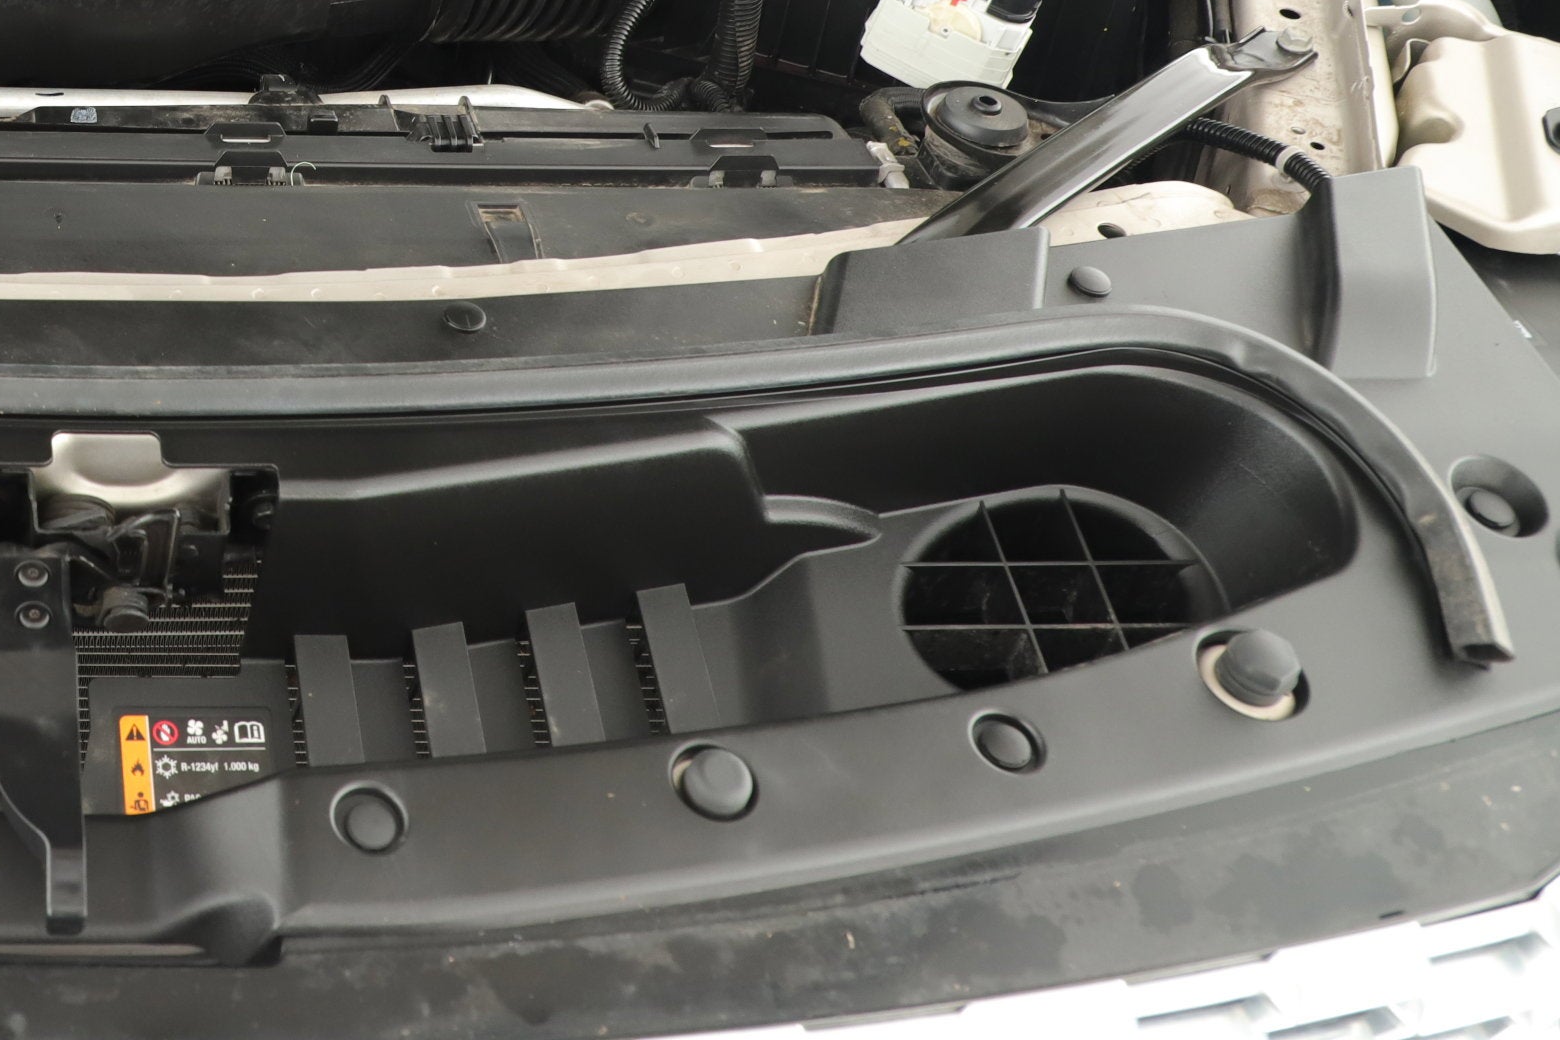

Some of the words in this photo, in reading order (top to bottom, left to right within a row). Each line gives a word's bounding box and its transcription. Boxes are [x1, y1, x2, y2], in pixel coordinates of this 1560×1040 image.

[187, 736, 206, 744] AUTO
[181, 762, 218, 773] R-1234yf
[224, 762, 246, 771] 1.000
[248, 762, 259, 772] kg
